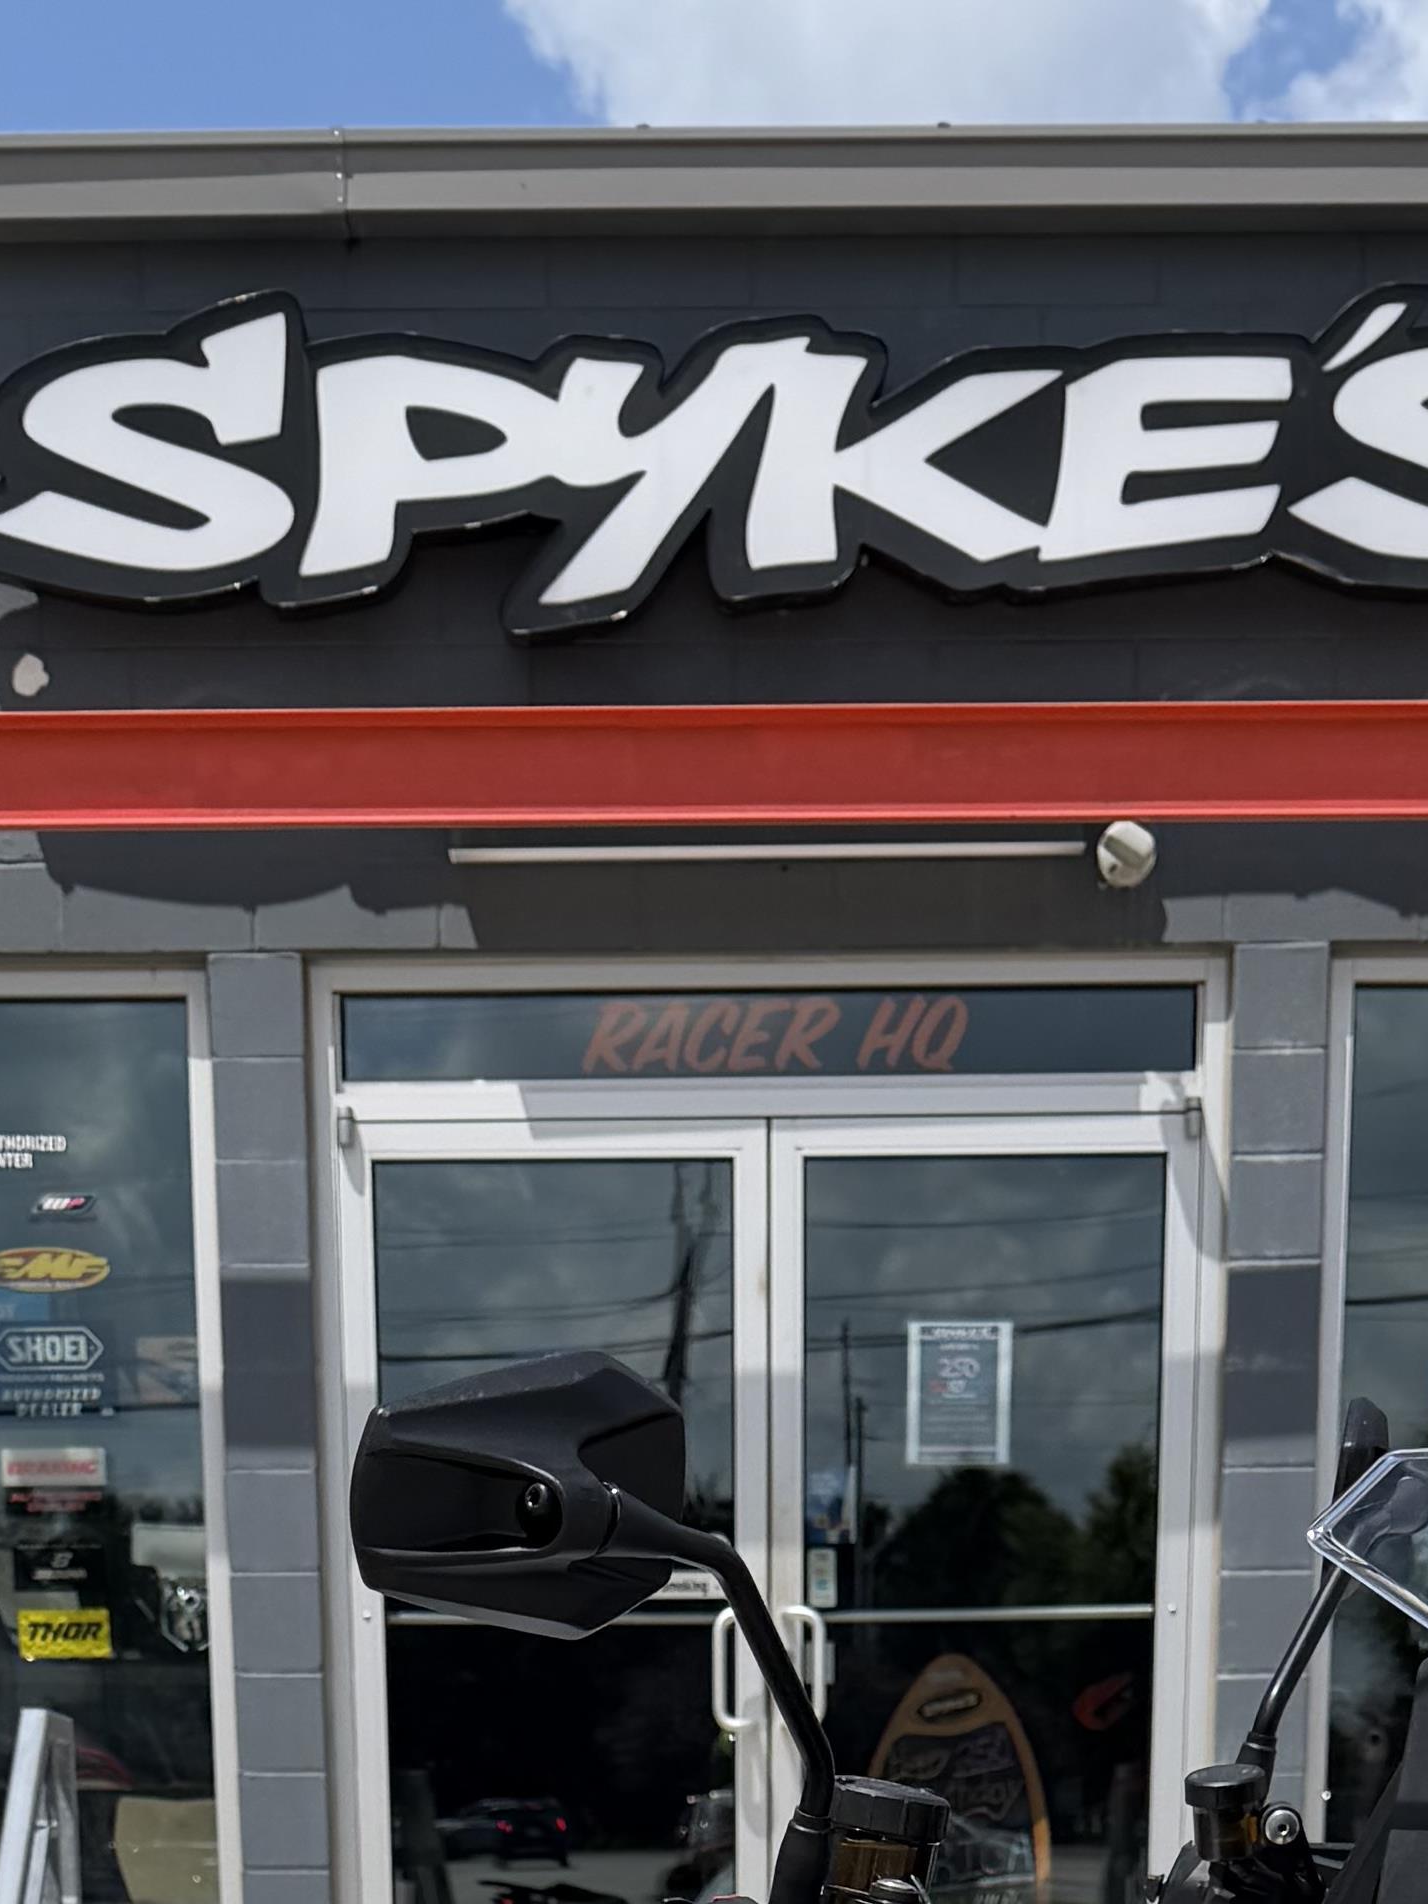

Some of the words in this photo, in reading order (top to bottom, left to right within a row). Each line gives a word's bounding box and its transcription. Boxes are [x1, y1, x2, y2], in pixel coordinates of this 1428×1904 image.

[580, 998, 841, 1075] RACER
[856, 994, 970, 1073] HQ
[4, 1334, 89, 1364] SHOEI
[27, 1622, 103, 1642] THOR
